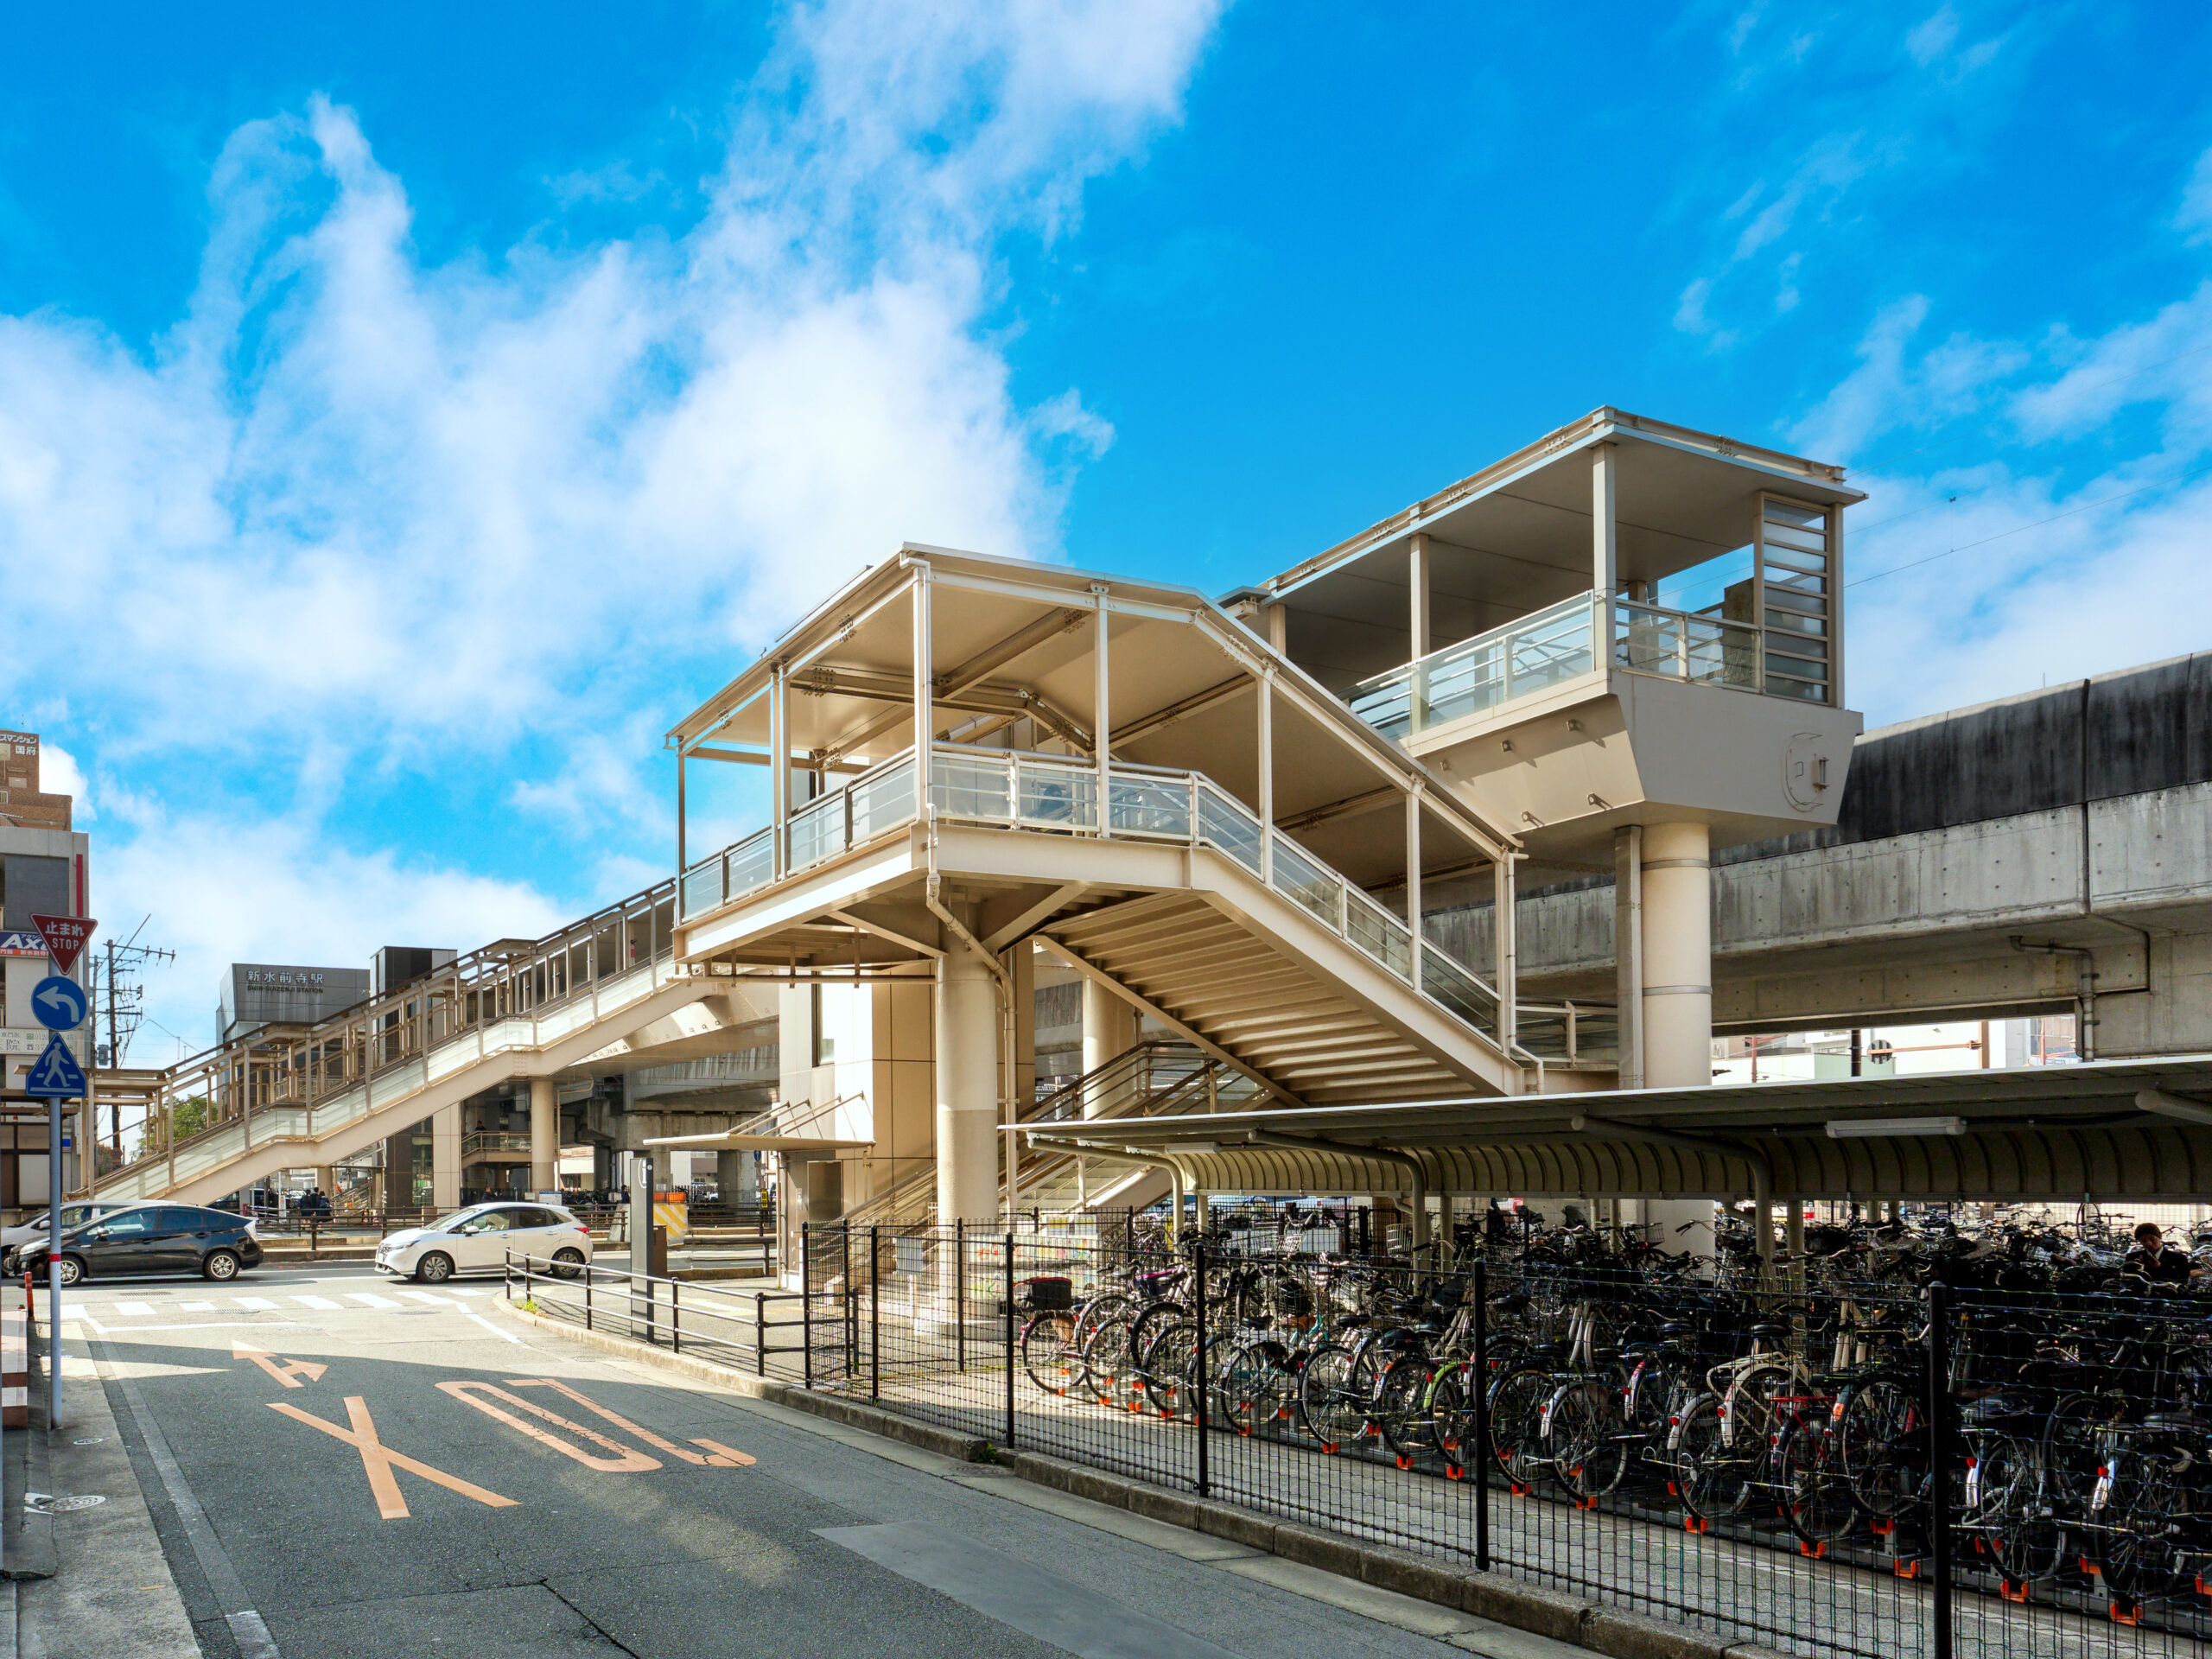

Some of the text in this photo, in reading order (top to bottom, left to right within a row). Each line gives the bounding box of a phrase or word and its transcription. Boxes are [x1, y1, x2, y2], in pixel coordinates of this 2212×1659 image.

[45, 920, 85, 937] 止まれ
[52, 938, 79, 950] STOP
[247, 970, 323, 984] 新水前寺駅
